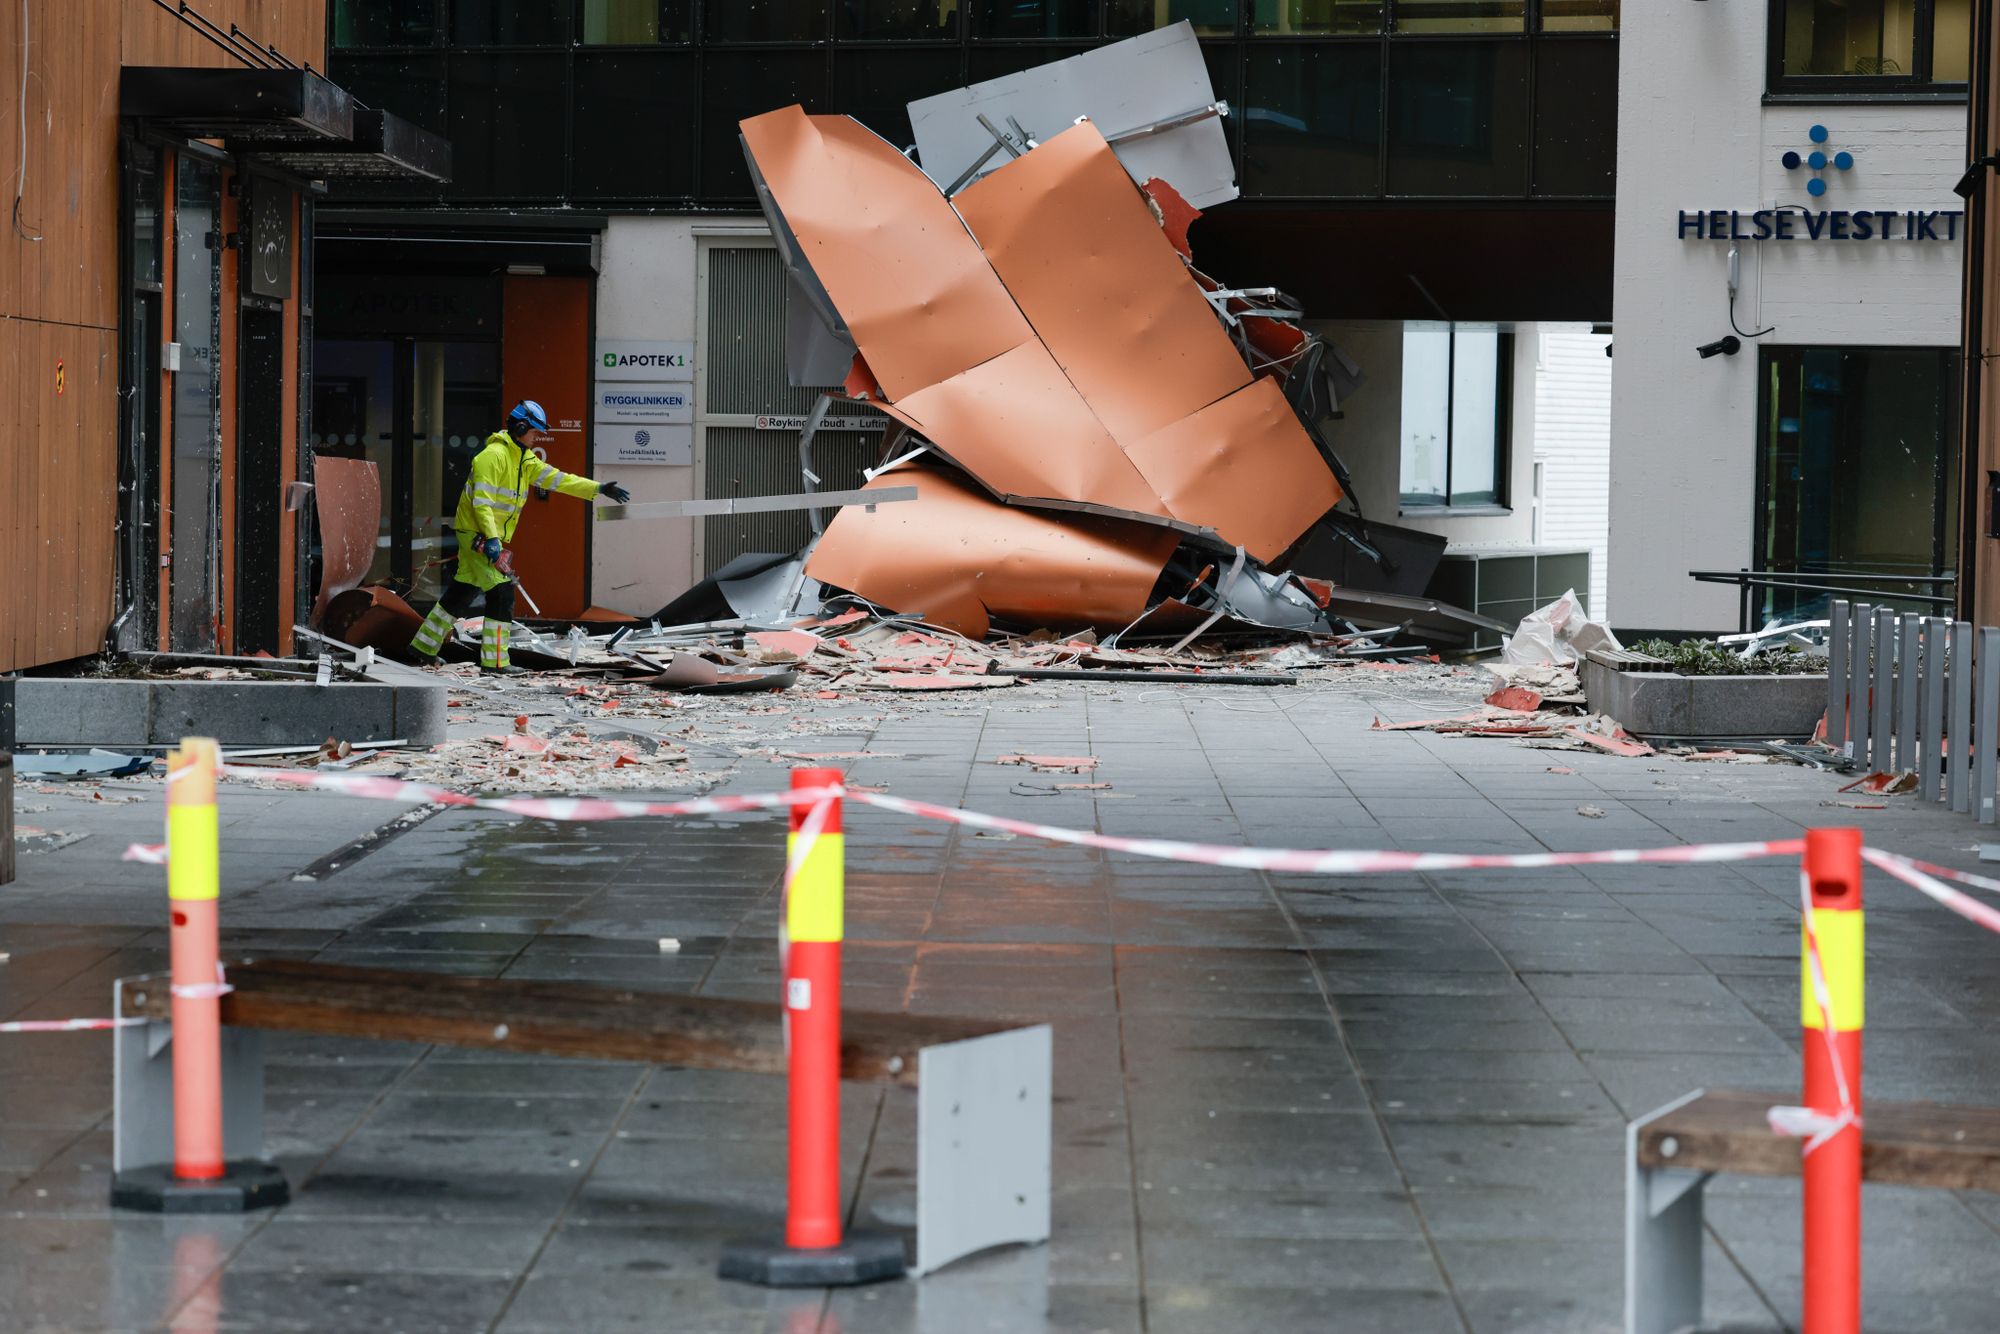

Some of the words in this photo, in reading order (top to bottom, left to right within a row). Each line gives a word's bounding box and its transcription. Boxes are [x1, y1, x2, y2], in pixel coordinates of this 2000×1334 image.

[1678, 210, 1794, 240] HELSE
[1803, 210, 1898, 240] VEST
[1907, 210, 1964, 241] IKT
[618, 355, 675, 367] APOTEK
[677, 355, 685, 367] 1
[604, 395, 683, 406] RYGGKLINIKKEN
[819, 418, 845, 428] rbudt
[860, 419, 887, 429] Luftin
[618, 448, 666, 456] Årstadklinikken
